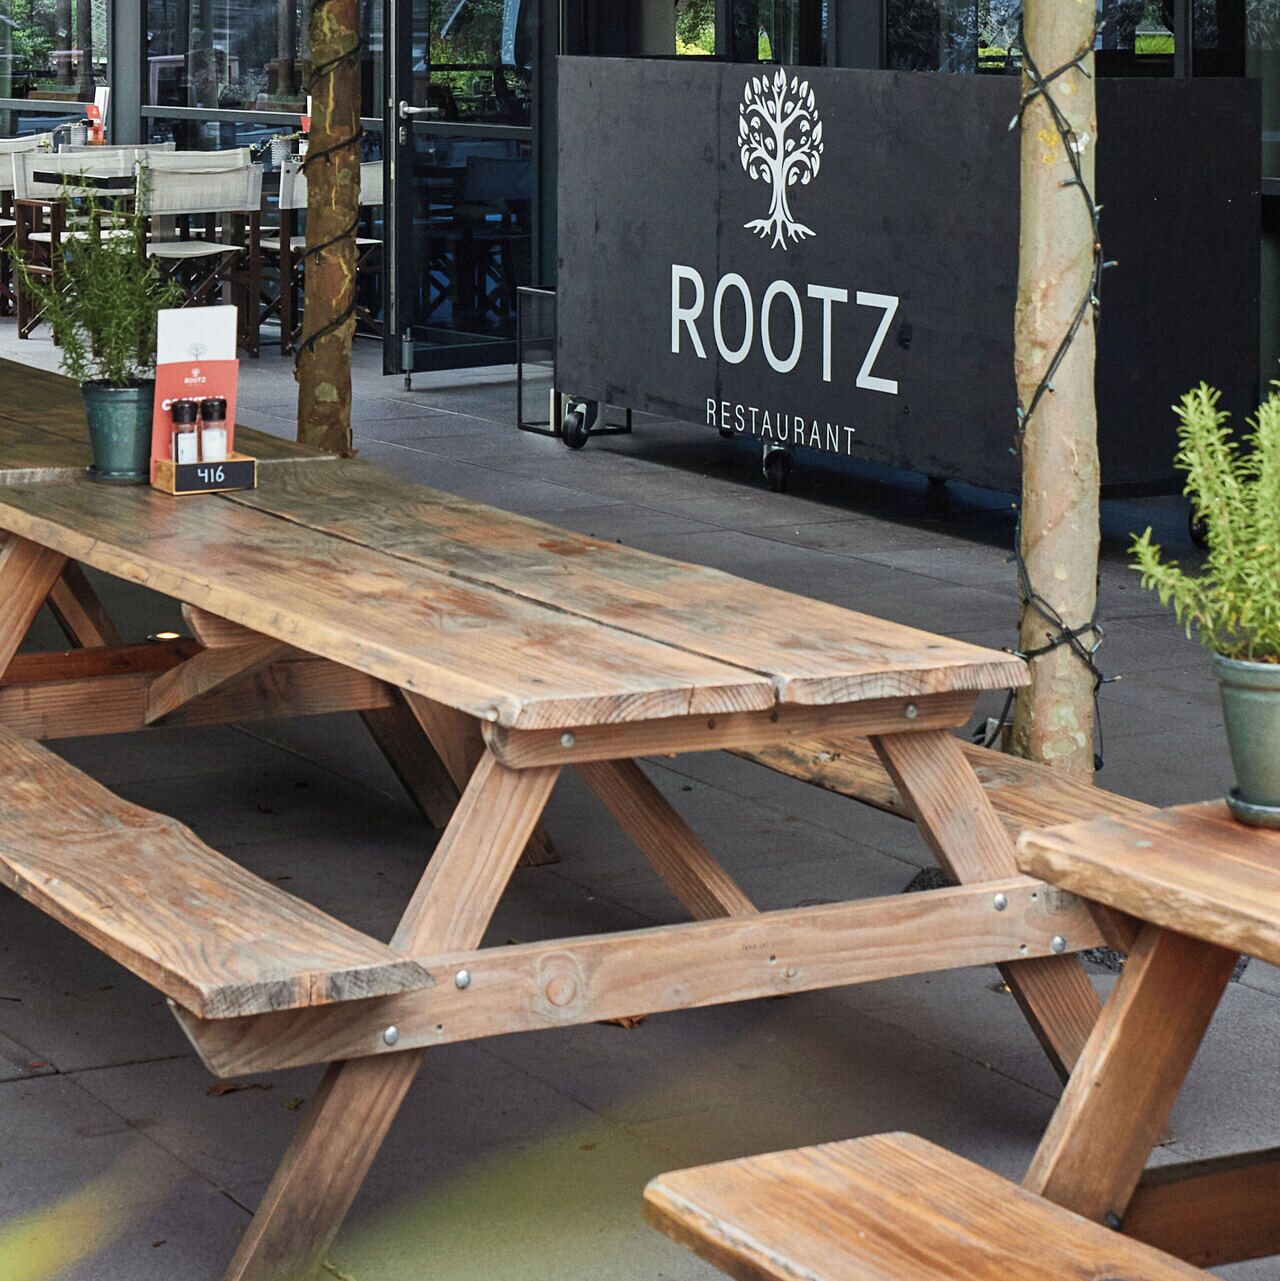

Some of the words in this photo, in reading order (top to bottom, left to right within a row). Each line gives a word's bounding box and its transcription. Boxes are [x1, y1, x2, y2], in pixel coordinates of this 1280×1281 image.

[670, 263, 900, 395] ROOTZ
[705, 398, 856, 457] RESTAURANT
[197, 465, 226, 484] 416
